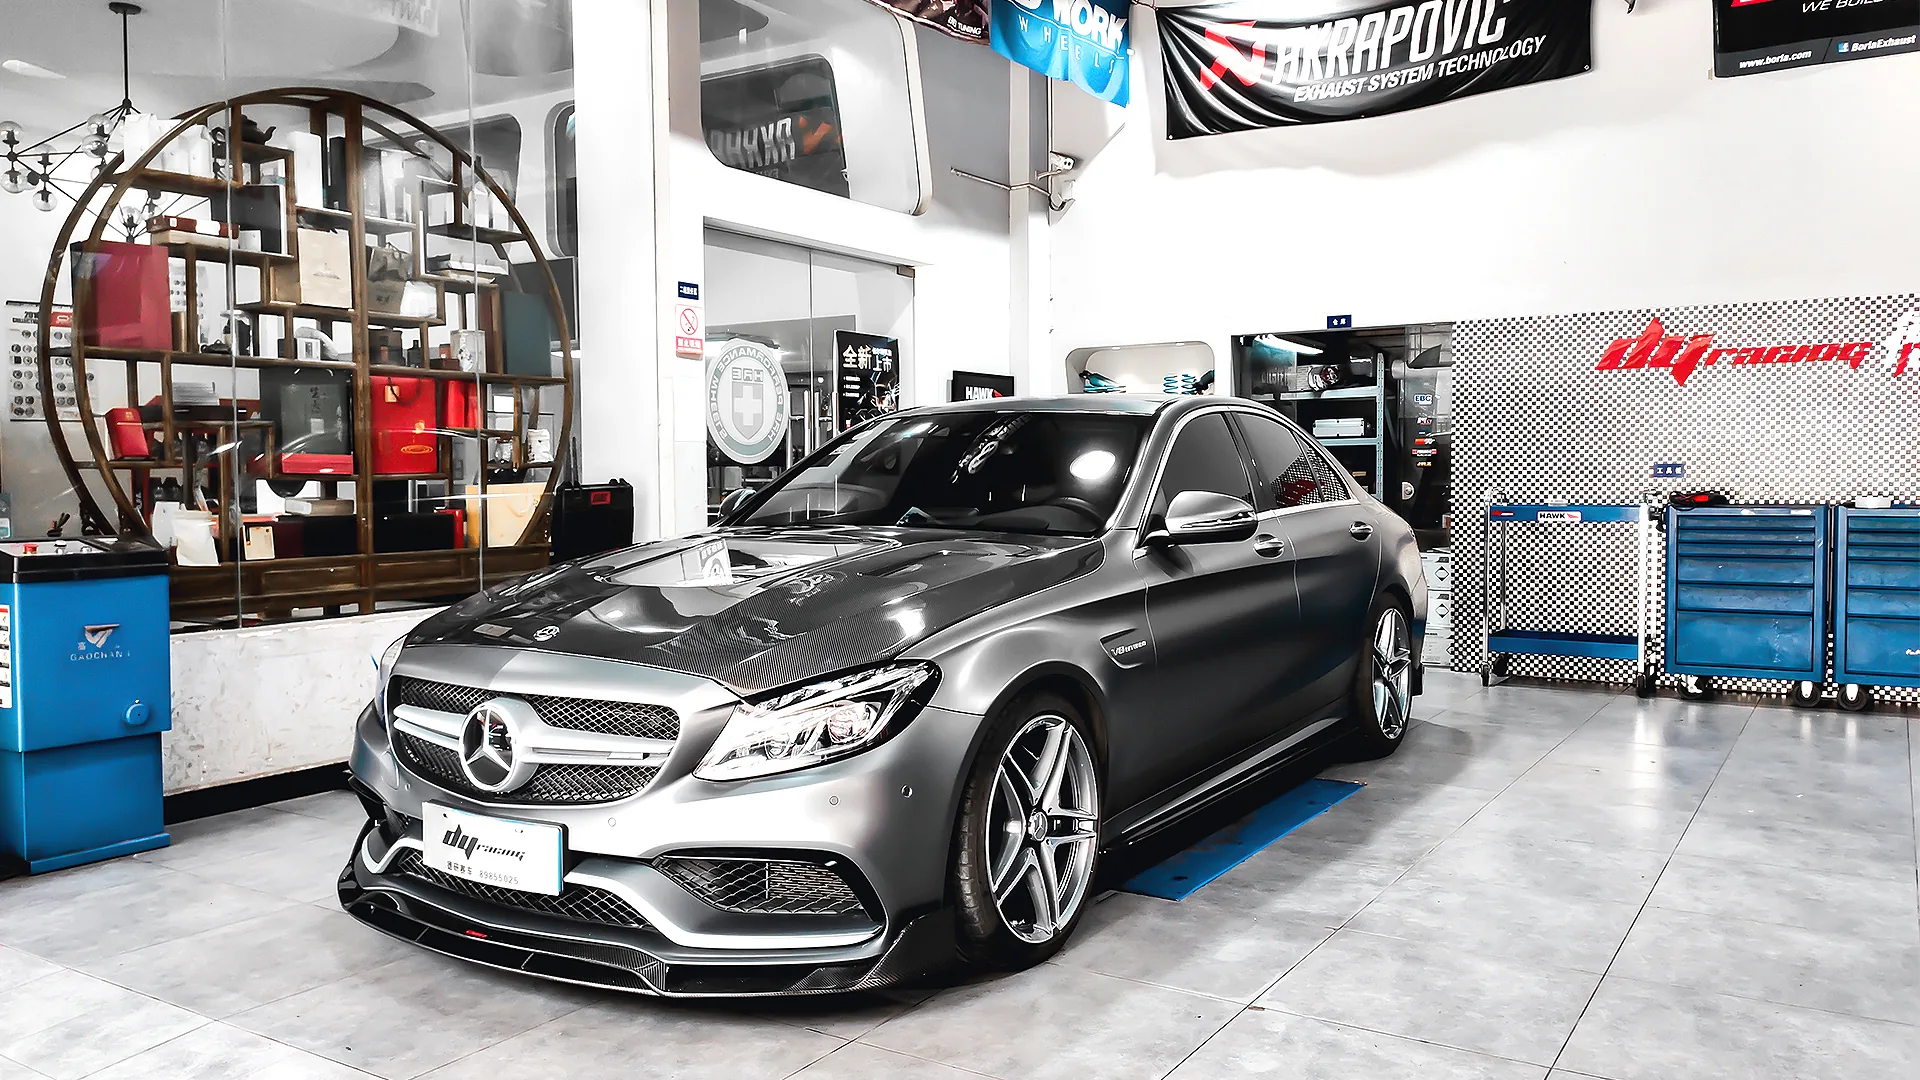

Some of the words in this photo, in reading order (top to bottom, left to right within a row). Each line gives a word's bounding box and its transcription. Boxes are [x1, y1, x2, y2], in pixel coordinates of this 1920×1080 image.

[1802, 0, 1831, 13] WE
[1052, 0, 1127, 54] WORK
[1018, 14, 1115, 74] WHEELS
[1293, 77, 1368, 103] EXHAUST
[1367, 62, 1435, 92] SYSTEM
[1437, 34, 1547, 78] TECHNOLOGY
[842, 344, 872, 370] 全新
[873, 354, 893, 373] 上市
[965, 385, 994, 400] HAWK
[1539, 508, 1566, 519] HAWK
